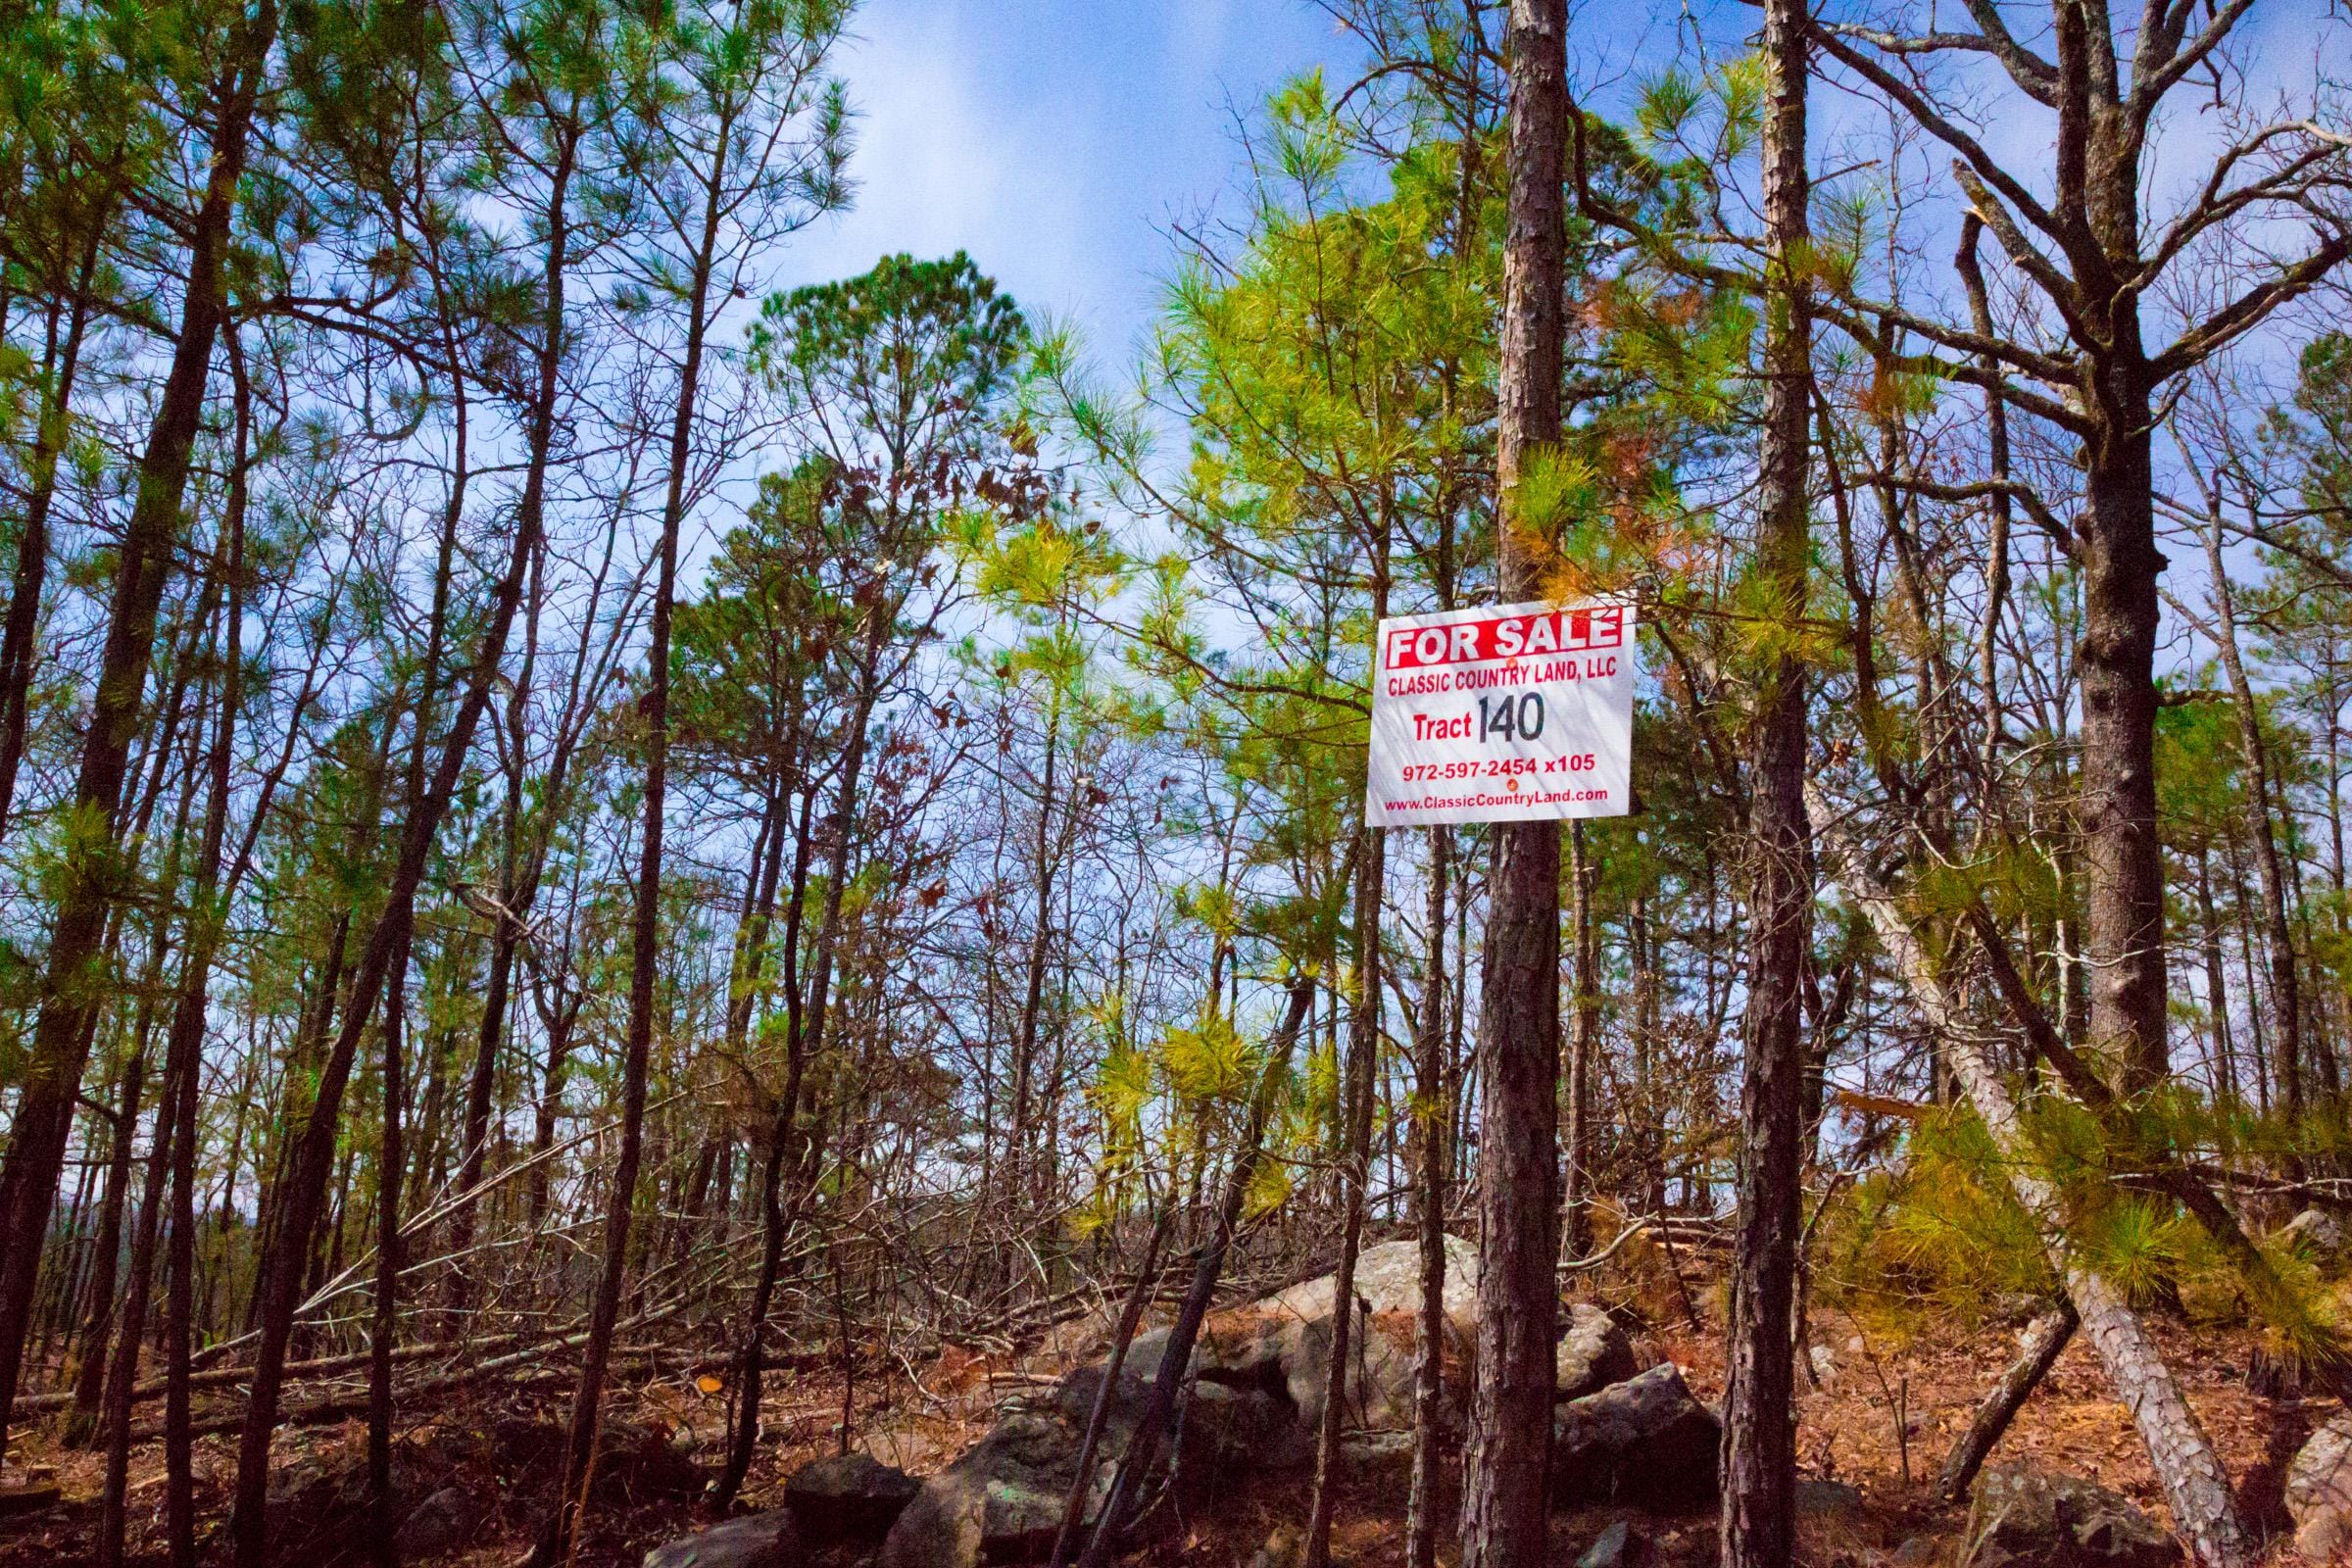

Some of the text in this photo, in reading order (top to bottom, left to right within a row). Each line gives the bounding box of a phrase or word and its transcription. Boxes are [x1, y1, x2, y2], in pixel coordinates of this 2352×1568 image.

[1389, 609, 1619, 668] FOR SALE
[1388, 657, 1617, 697] CLASSIC COUNTRY LAND, LLC
[1412, 692, 1545, 744] Tract 140
[1402, 754, 1596, 782] 972-597-2454 x105
[1385, 788, 1608, 811] www.ClassicCountryLand.com
